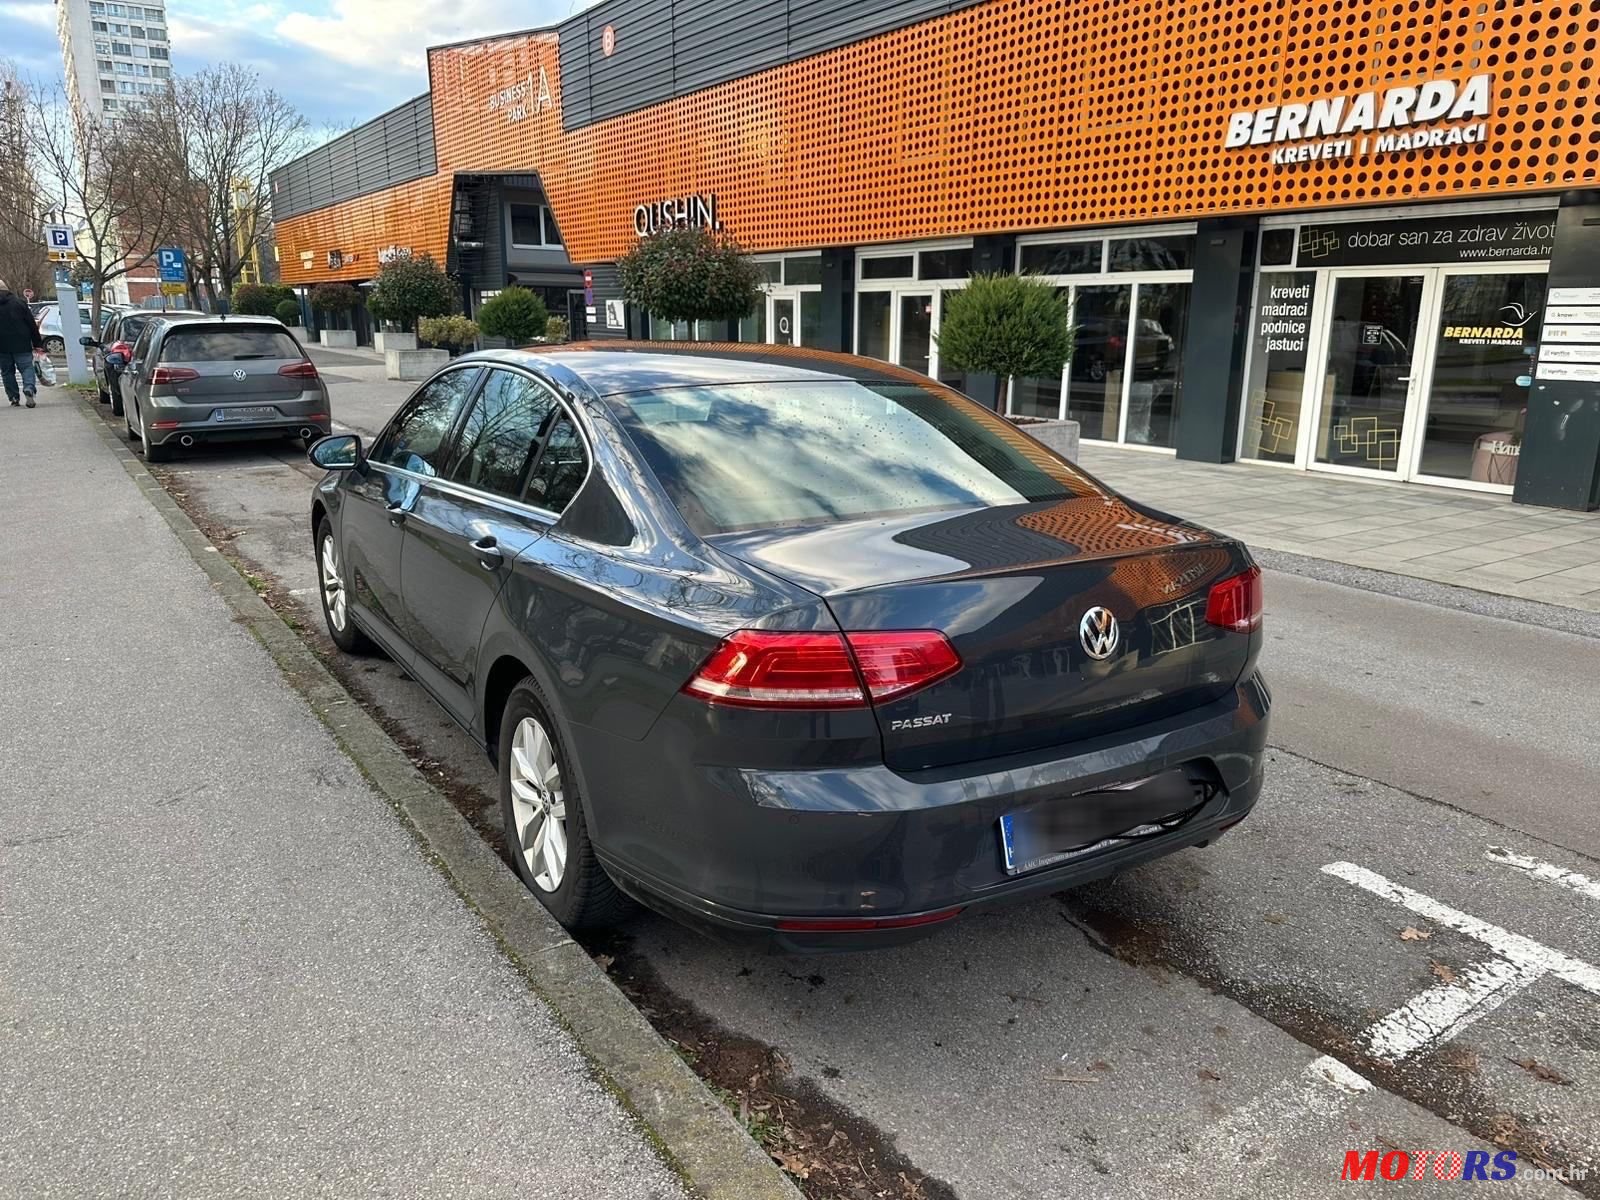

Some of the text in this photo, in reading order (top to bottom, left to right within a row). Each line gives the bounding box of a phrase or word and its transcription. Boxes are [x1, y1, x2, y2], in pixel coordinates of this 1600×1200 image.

[489, 81, 526, 111] BUSINESS
[507, 104, 528, 124] PARK
[1224, 74, 1489, 148] BERNARDA
[1271, 123, 1488, 165] KREVETI I MADRACI
[55, 232, 65, 244] P
[1348, 221, 1556, 248] dobar san za zdrav život
[162, 251, 174, 266] P
[1460, 244, 1553, 258] www.bernarda.hr
[1270, 285, 1310, 299] kreveti
[1262, 302, 1308, 316] madraci
[780, 316, 790, 334] Q
[1261, 319, 1306, 336] podnice
[1443, 327, 1524, 339] BERNARDA
[1265, 336, 1304, 353] jastuci
[1459, 338, 1485, 346] KREVETI
[1491, 339, 1523, 347] MADRACI
[891, 713, 953, 731] PASSAT
